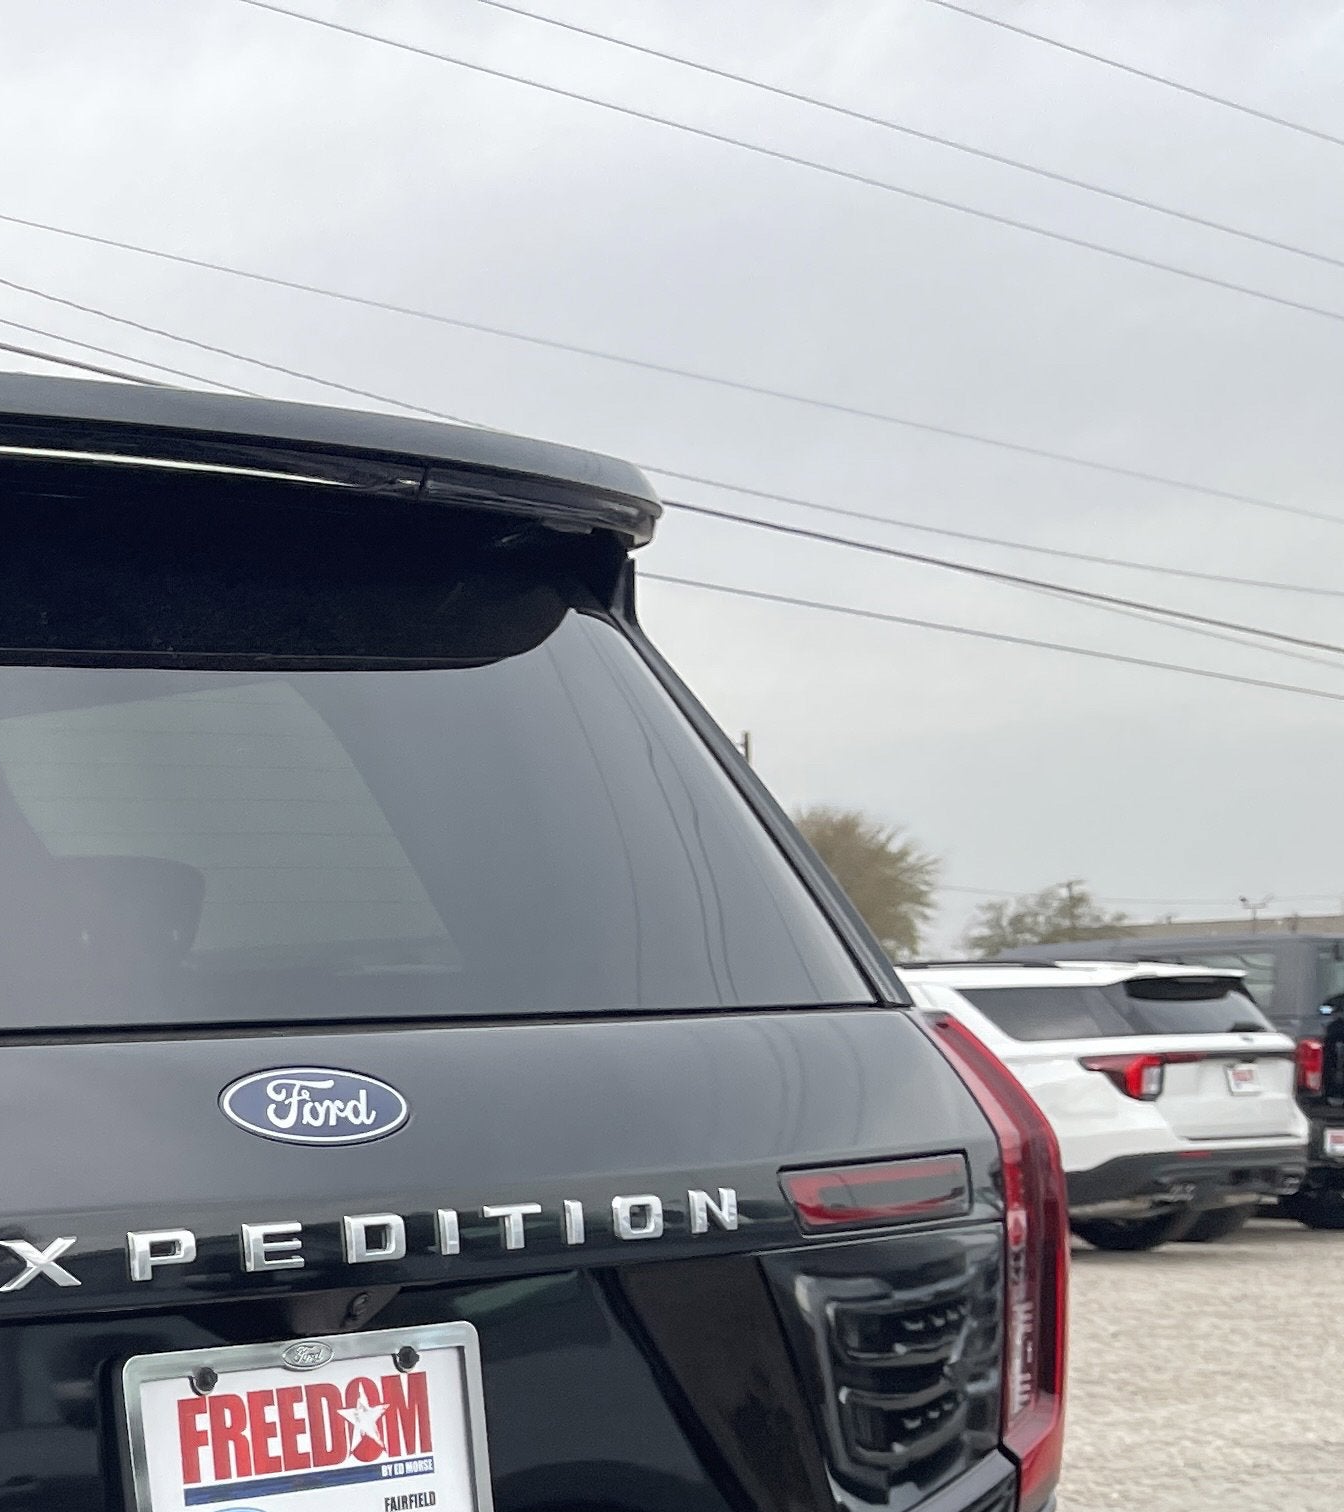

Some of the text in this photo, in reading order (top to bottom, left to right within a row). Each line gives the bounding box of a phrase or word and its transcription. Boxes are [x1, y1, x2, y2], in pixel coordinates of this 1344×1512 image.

[266, 1080, 377, 1128] Ford
[294, 1346, 324, 1365] Ford
[177, 1371, 433, 1484] FREEDOM
[381, 1458, 434, 1478] BY ED MORSE
[384, 1491, 437, 1512] FAIRFIELD
